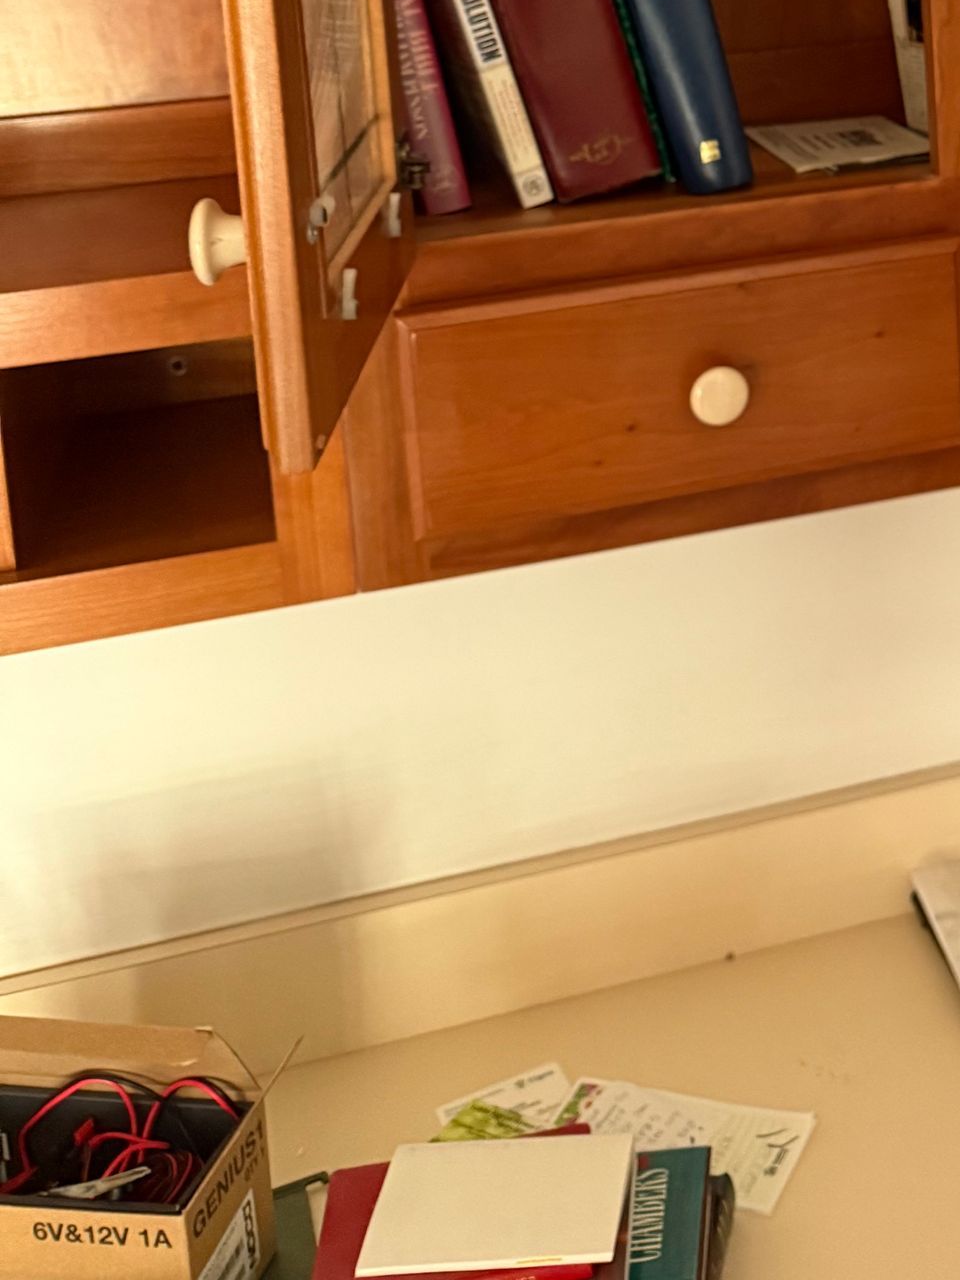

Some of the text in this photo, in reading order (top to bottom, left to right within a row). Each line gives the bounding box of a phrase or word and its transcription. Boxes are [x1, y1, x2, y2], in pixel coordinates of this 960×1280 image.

[32, 1221, 173, 1249] 6V&12V 1A
[630, 1166, 670, 1264] CHAMBERS
